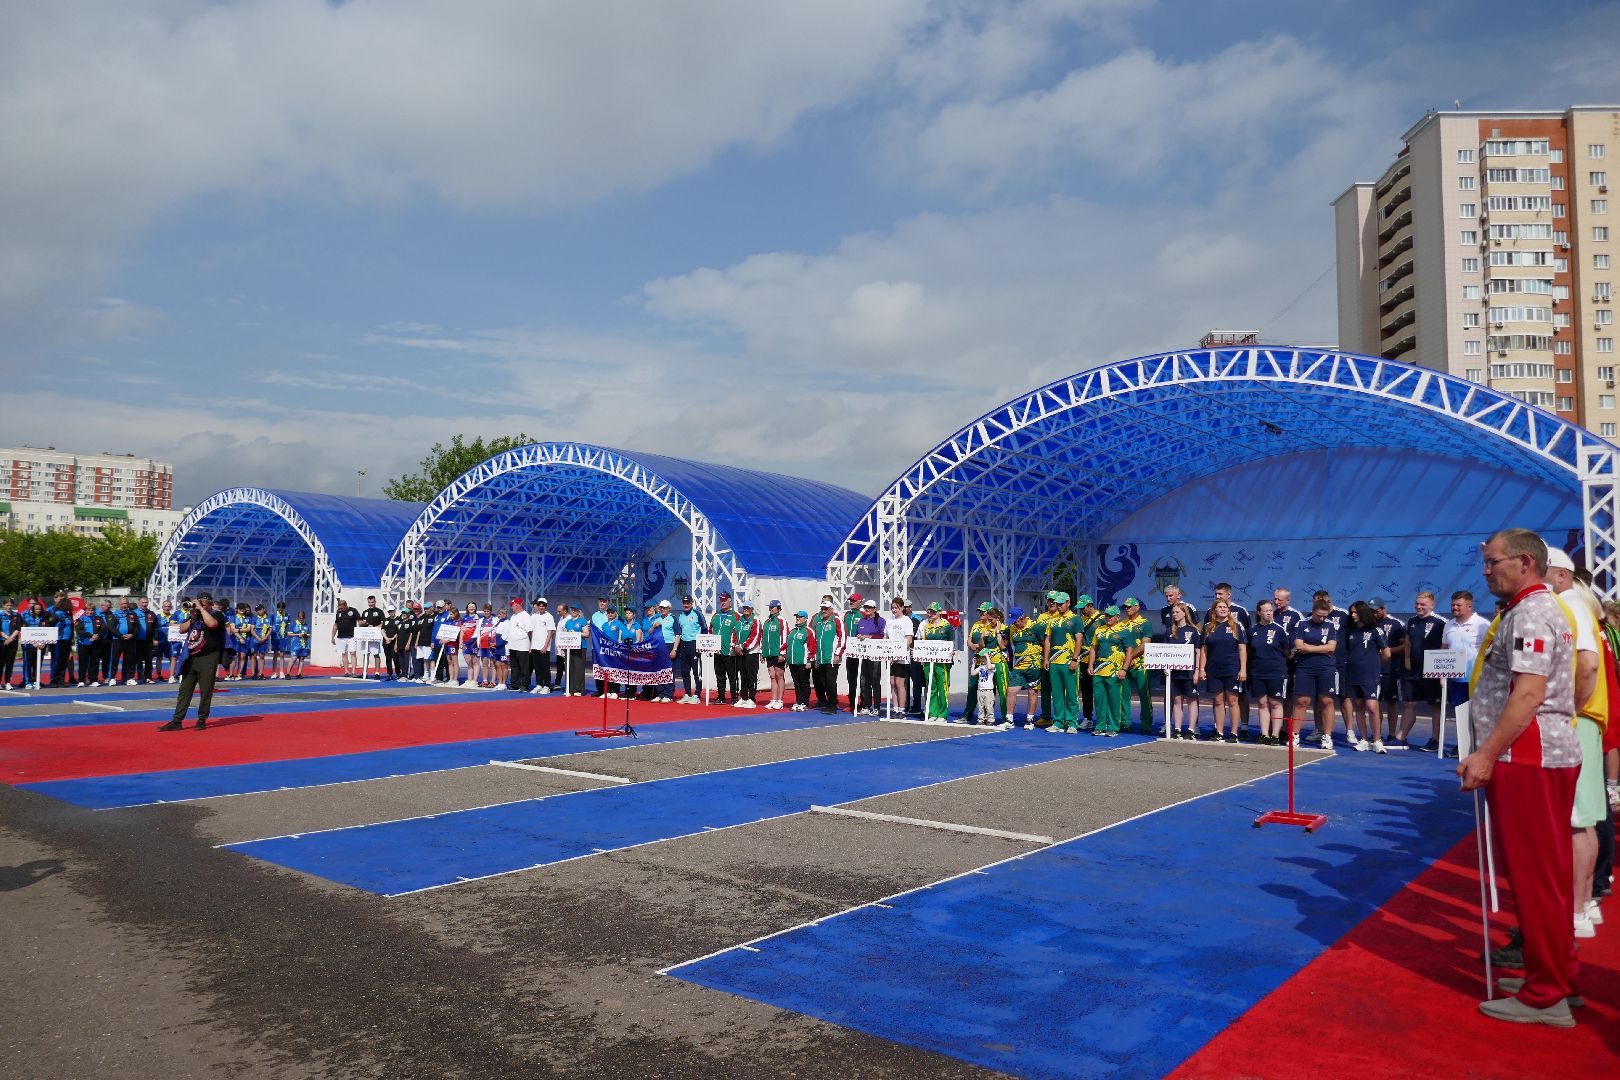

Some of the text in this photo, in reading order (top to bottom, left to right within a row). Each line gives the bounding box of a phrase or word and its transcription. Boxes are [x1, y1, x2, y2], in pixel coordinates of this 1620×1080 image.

[1266, 636, 1273, 644] 5
[1321, 636, 1328, 644] 4
[1362, 640, 1368, 649] 1
